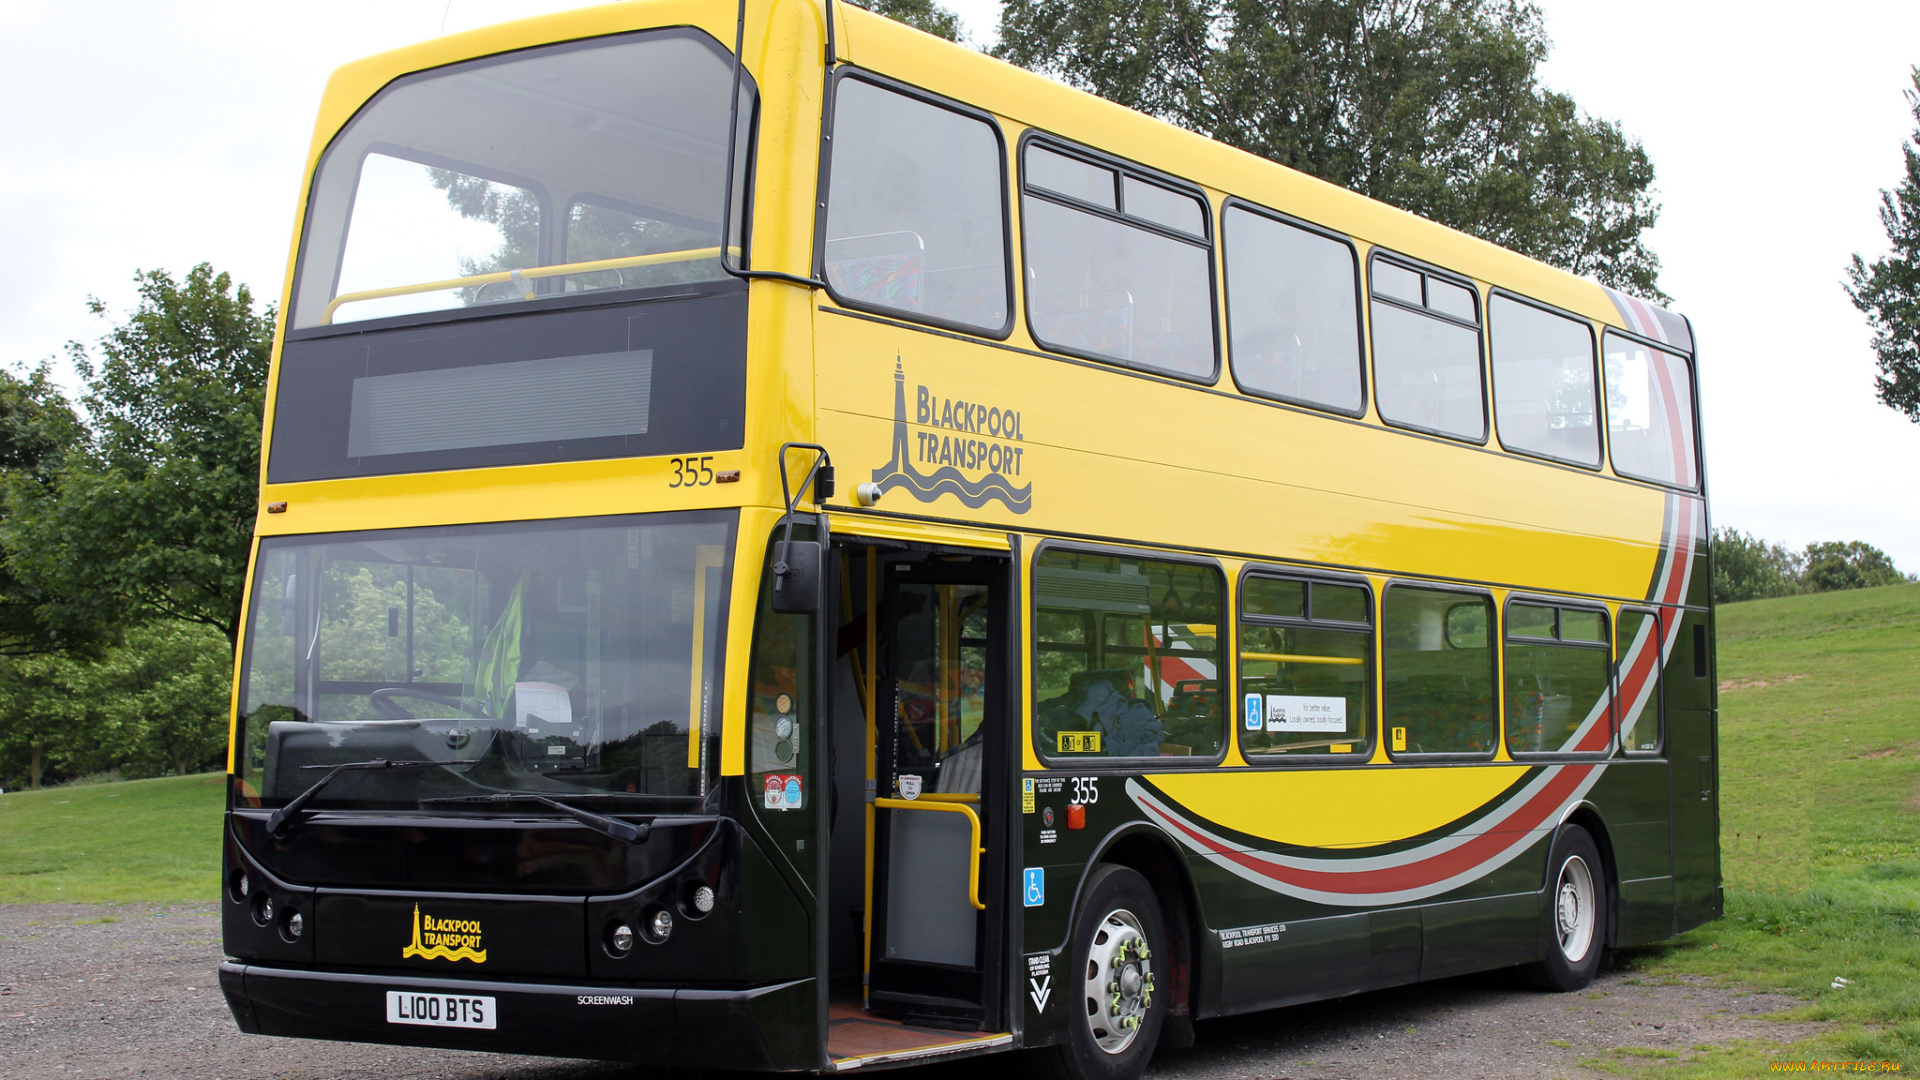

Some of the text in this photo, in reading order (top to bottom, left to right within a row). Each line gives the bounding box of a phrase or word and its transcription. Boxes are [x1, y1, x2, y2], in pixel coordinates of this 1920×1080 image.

[917, 384, 1024, 441] BLACKPOOL
[917, 431, 1024, 476] TRANSPORT
[669, 456, 713, 488] 355
[1071, 777, 1098, 804] 355
[424, 915, 481, 934] BLACKPOOL
[424, 932, 481, 948] TRANSPORT
[446, 998, 484, 1023] BTS
[577, 995, 633, 1005] SCREENWASH
